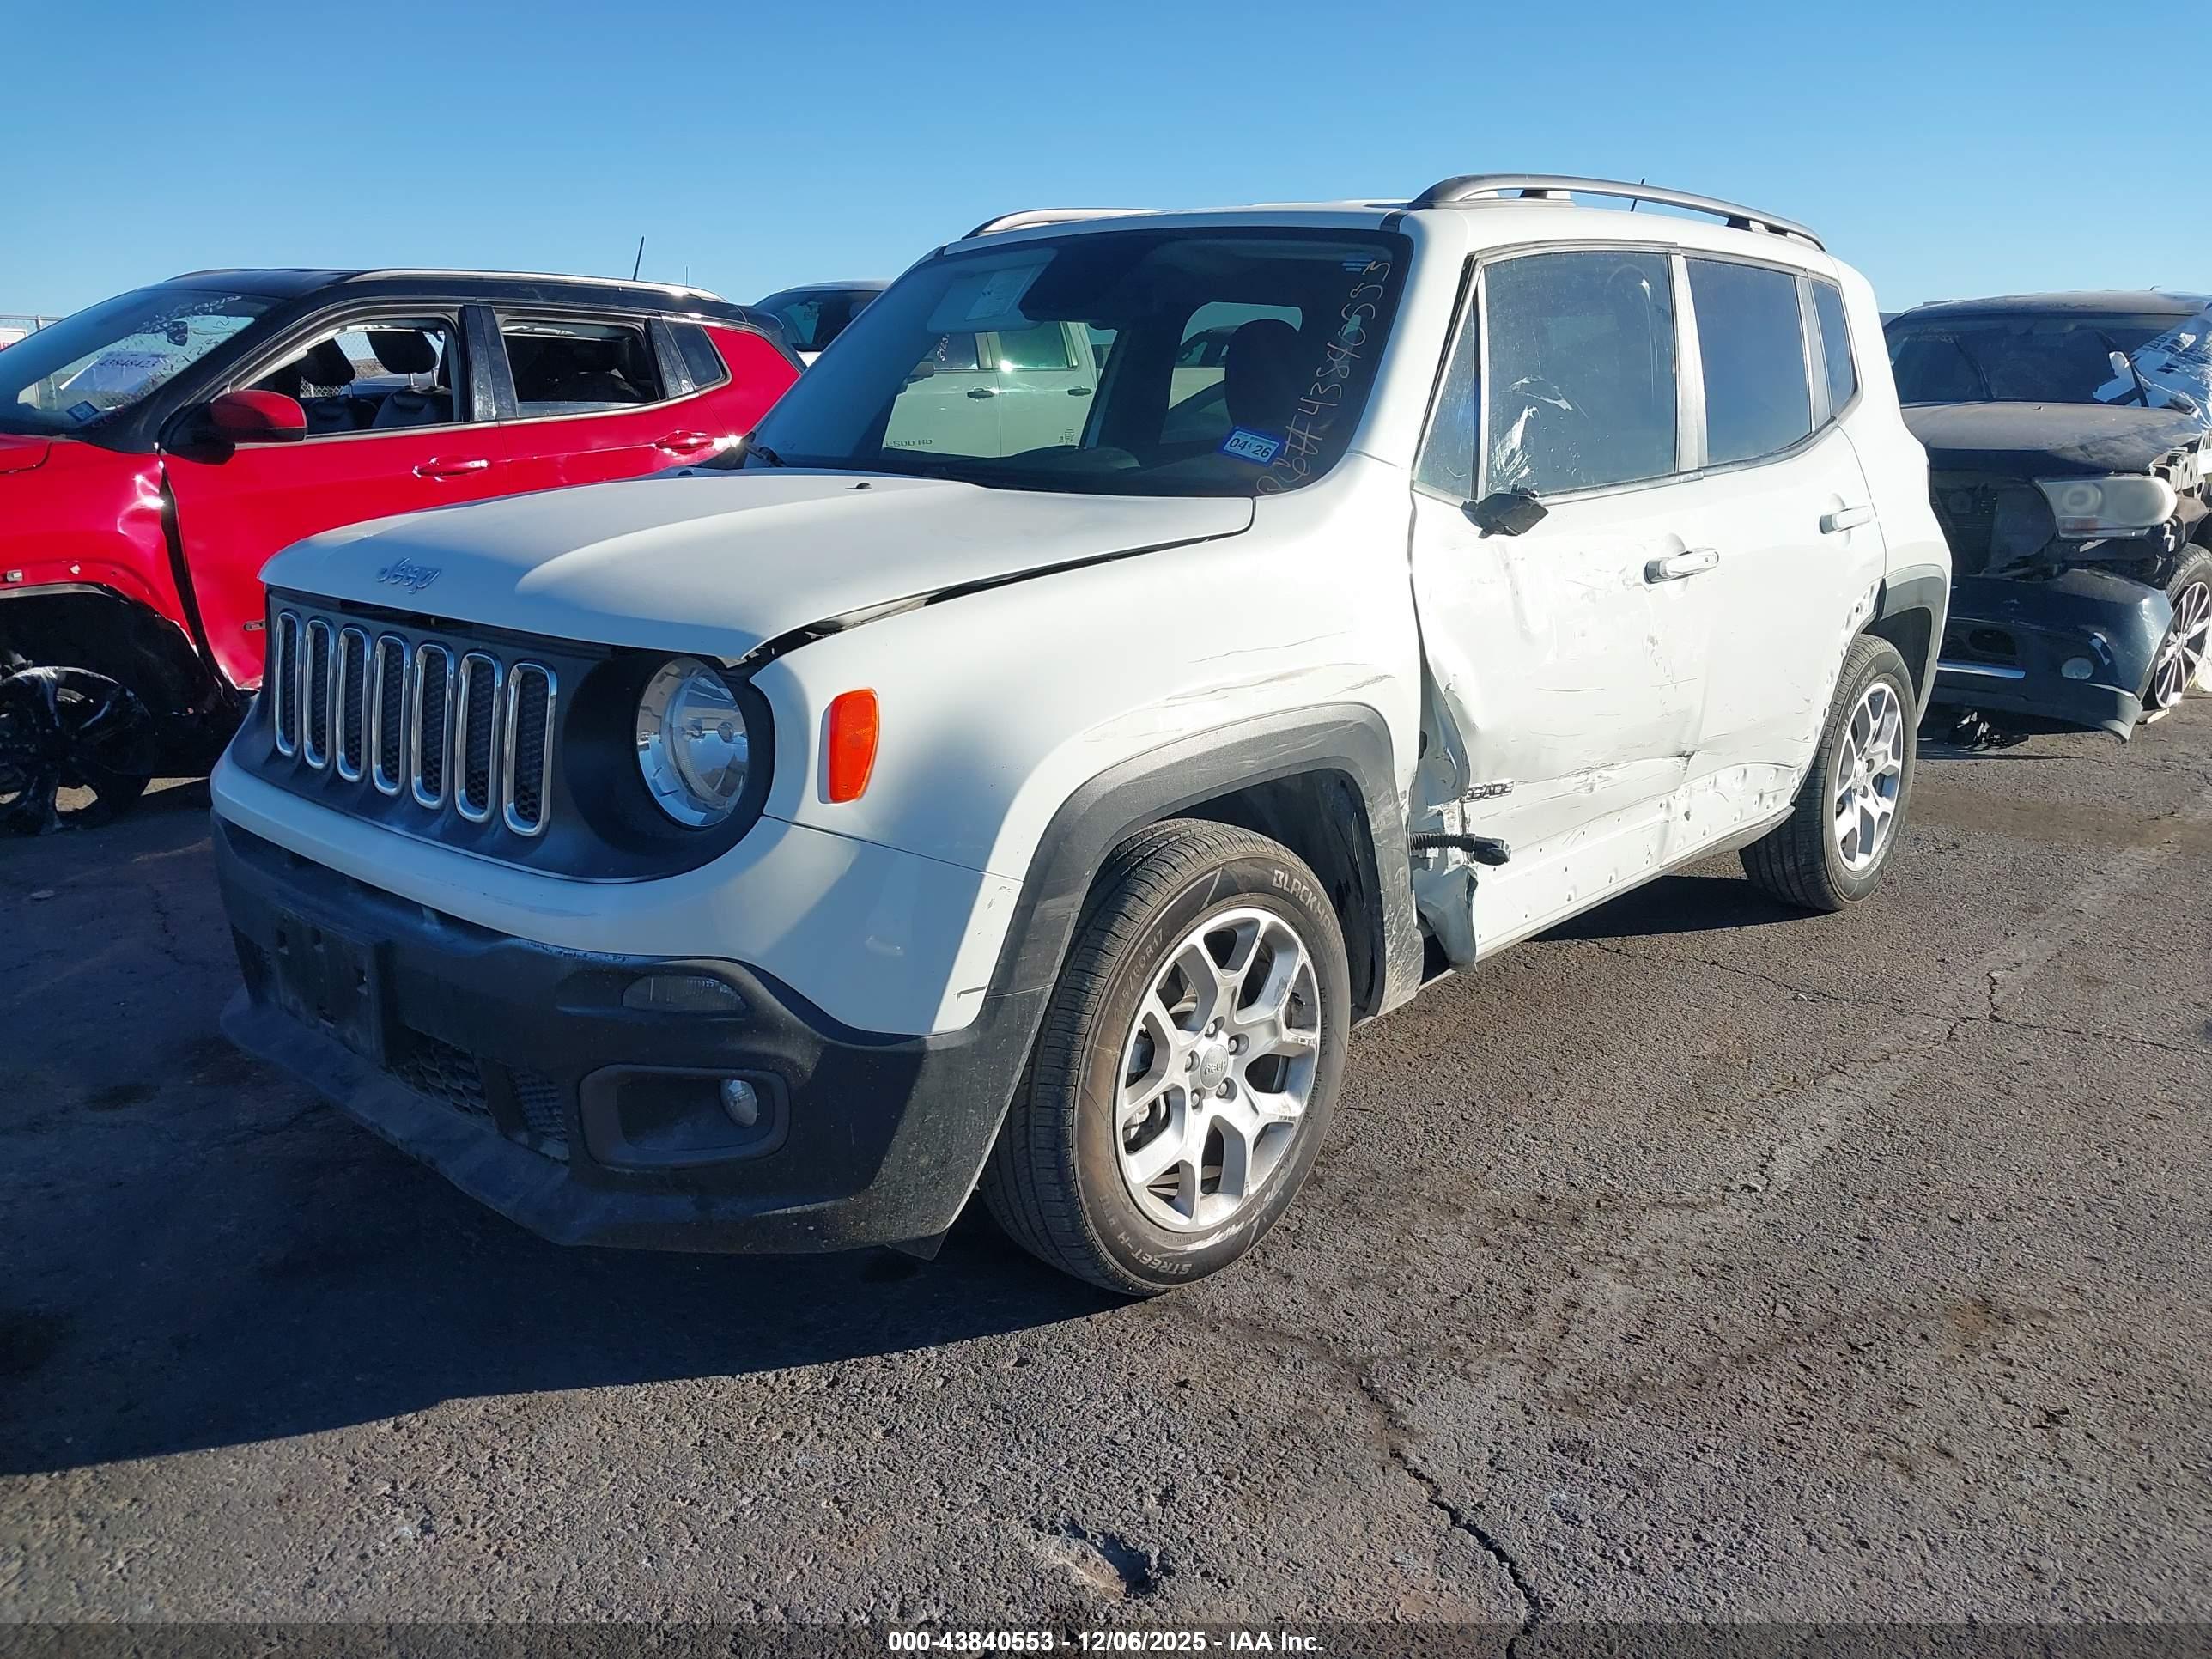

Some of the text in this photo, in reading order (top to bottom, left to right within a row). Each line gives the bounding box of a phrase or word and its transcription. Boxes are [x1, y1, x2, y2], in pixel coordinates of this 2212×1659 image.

[1229, 436, 1272, 459] 04 26
[377, 556, 441, 595] Jeep
